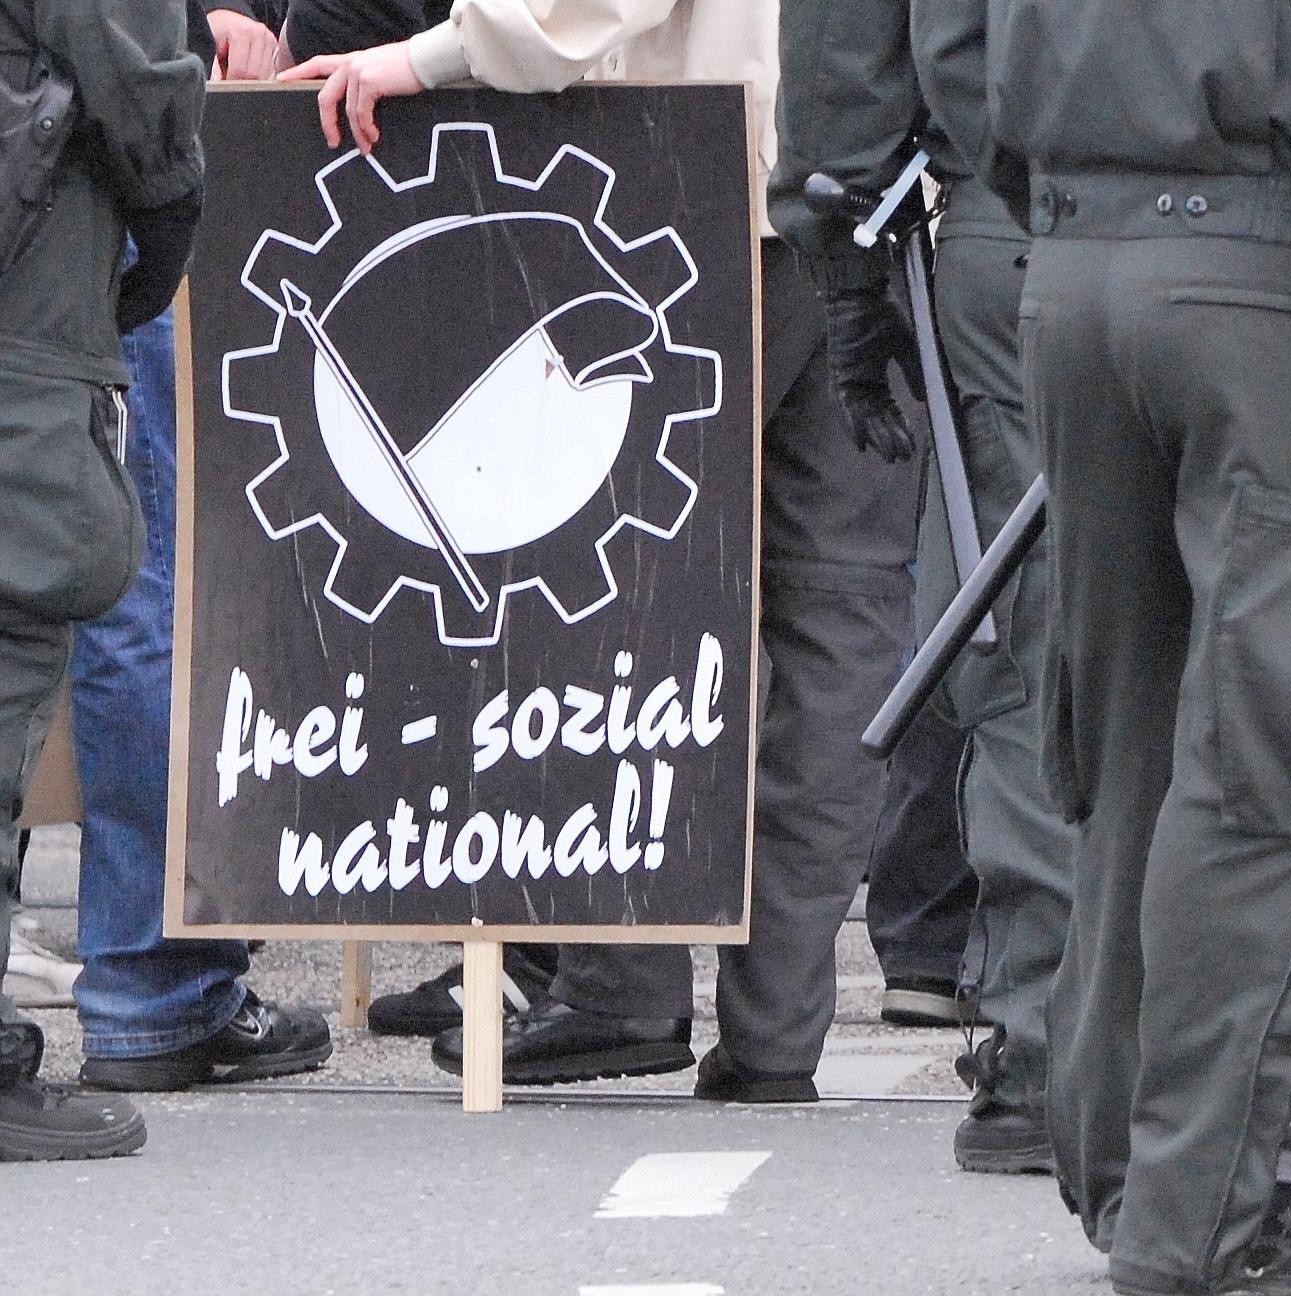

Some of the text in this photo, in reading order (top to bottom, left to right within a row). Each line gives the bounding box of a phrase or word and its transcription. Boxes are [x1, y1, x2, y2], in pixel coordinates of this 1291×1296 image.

[216, 666, 369, 808] frei
[472, 632, 725, 773] sozial
[278, 758, 674, 896] national!
